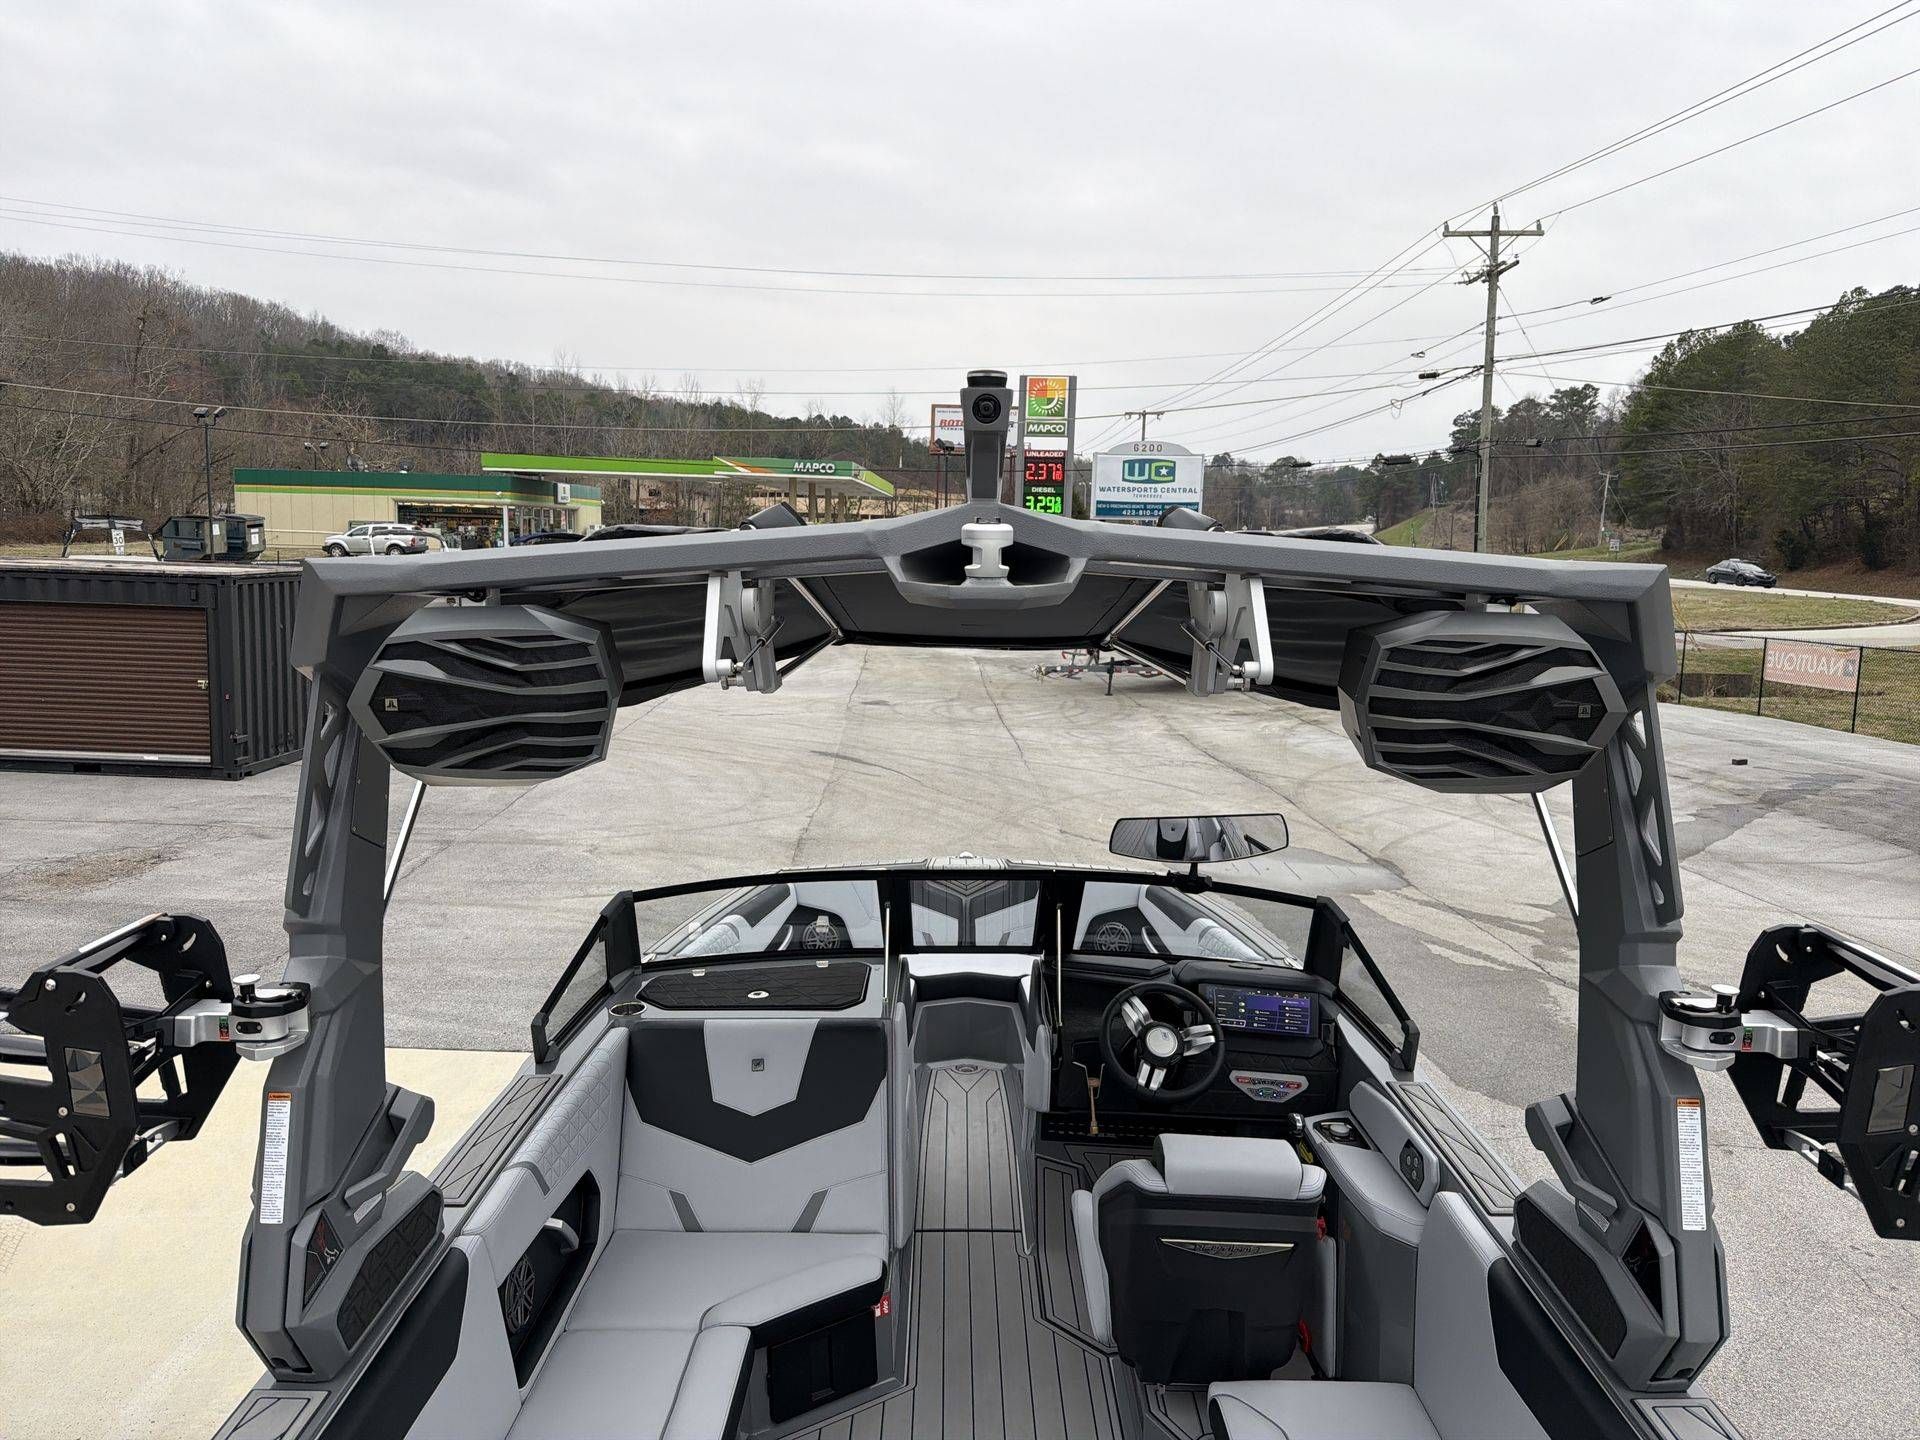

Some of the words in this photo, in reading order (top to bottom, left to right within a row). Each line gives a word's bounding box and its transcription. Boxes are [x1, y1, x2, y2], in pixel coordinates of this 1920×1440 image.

[1028, 424, 1064, 433] MAPCO
[1133, 444, 1163, 452] 6200
[793, 462, 835, 473] MAPCO
[1160, 486, 1198, 494] CENTRAL
[114, 536, 124, 545] 30
